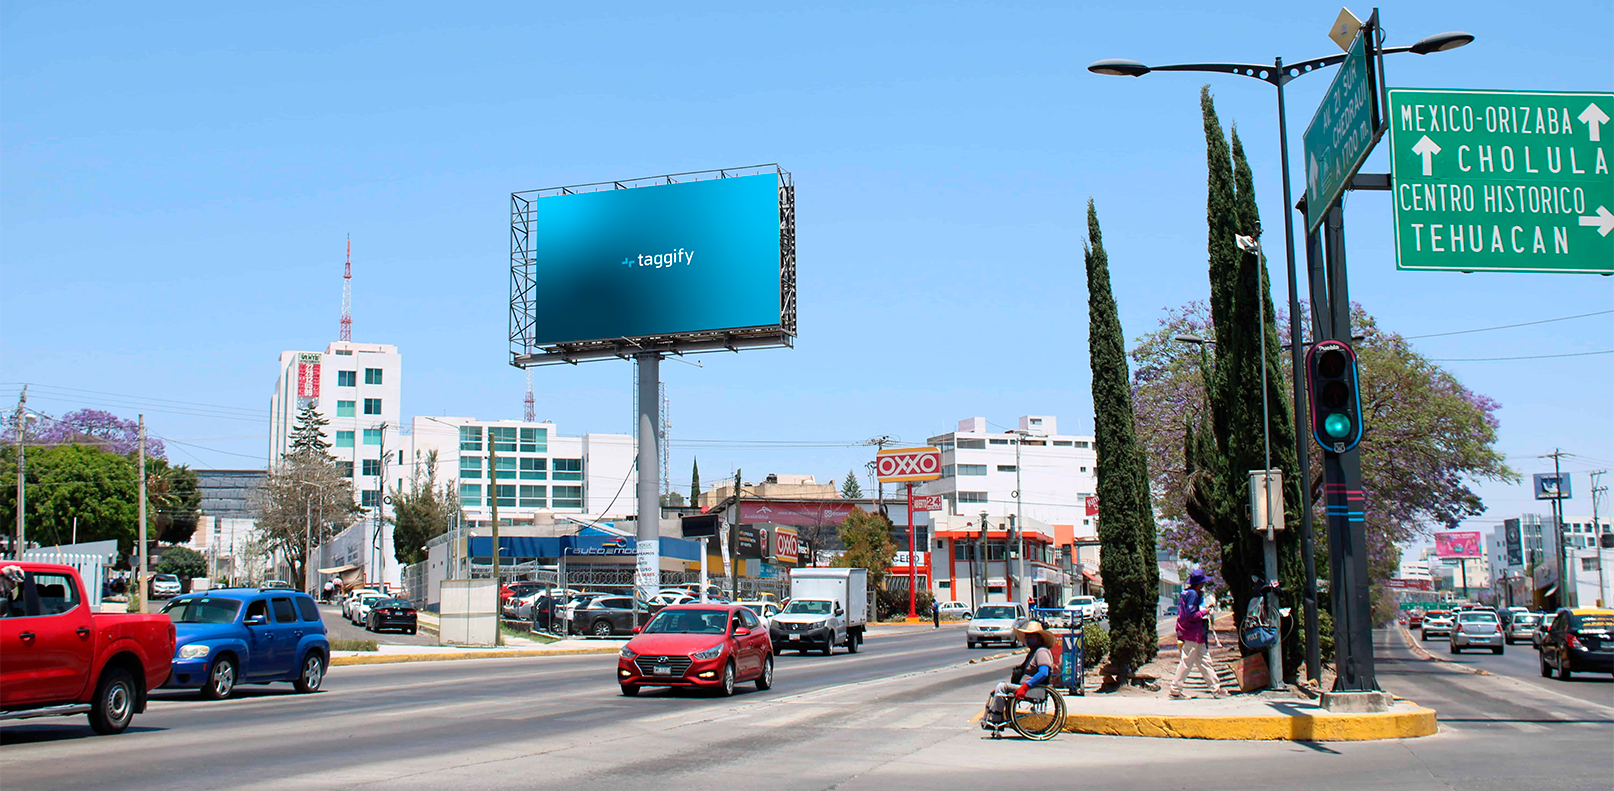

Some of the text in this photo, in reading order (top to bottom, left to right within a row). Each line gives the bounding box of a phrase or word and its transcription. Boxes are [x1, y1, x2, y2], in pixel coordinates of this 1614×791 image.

[1334, 87, 1341, 114] 21
[1343, 59, 1357, 97] SUR
[1333, 78, 1366, 148] CHEDRAUI
[1402, 105, 1573, 135] MEXICO-ORIZABA
[1342, 129, 1358, 169] 1700
[1459, 145, 1609, 175] CHOLULA
[1401, 184, 1586, 214] CENTRO HISTORICO
[1412, 224, 1569, 254] TEHUACAN
[638, 248, 694, 268] taggify
[879, 454, 937, 475] OXXO
[927, 497, 941, 506] 24
[778, 534, 797, 555] OXXO
